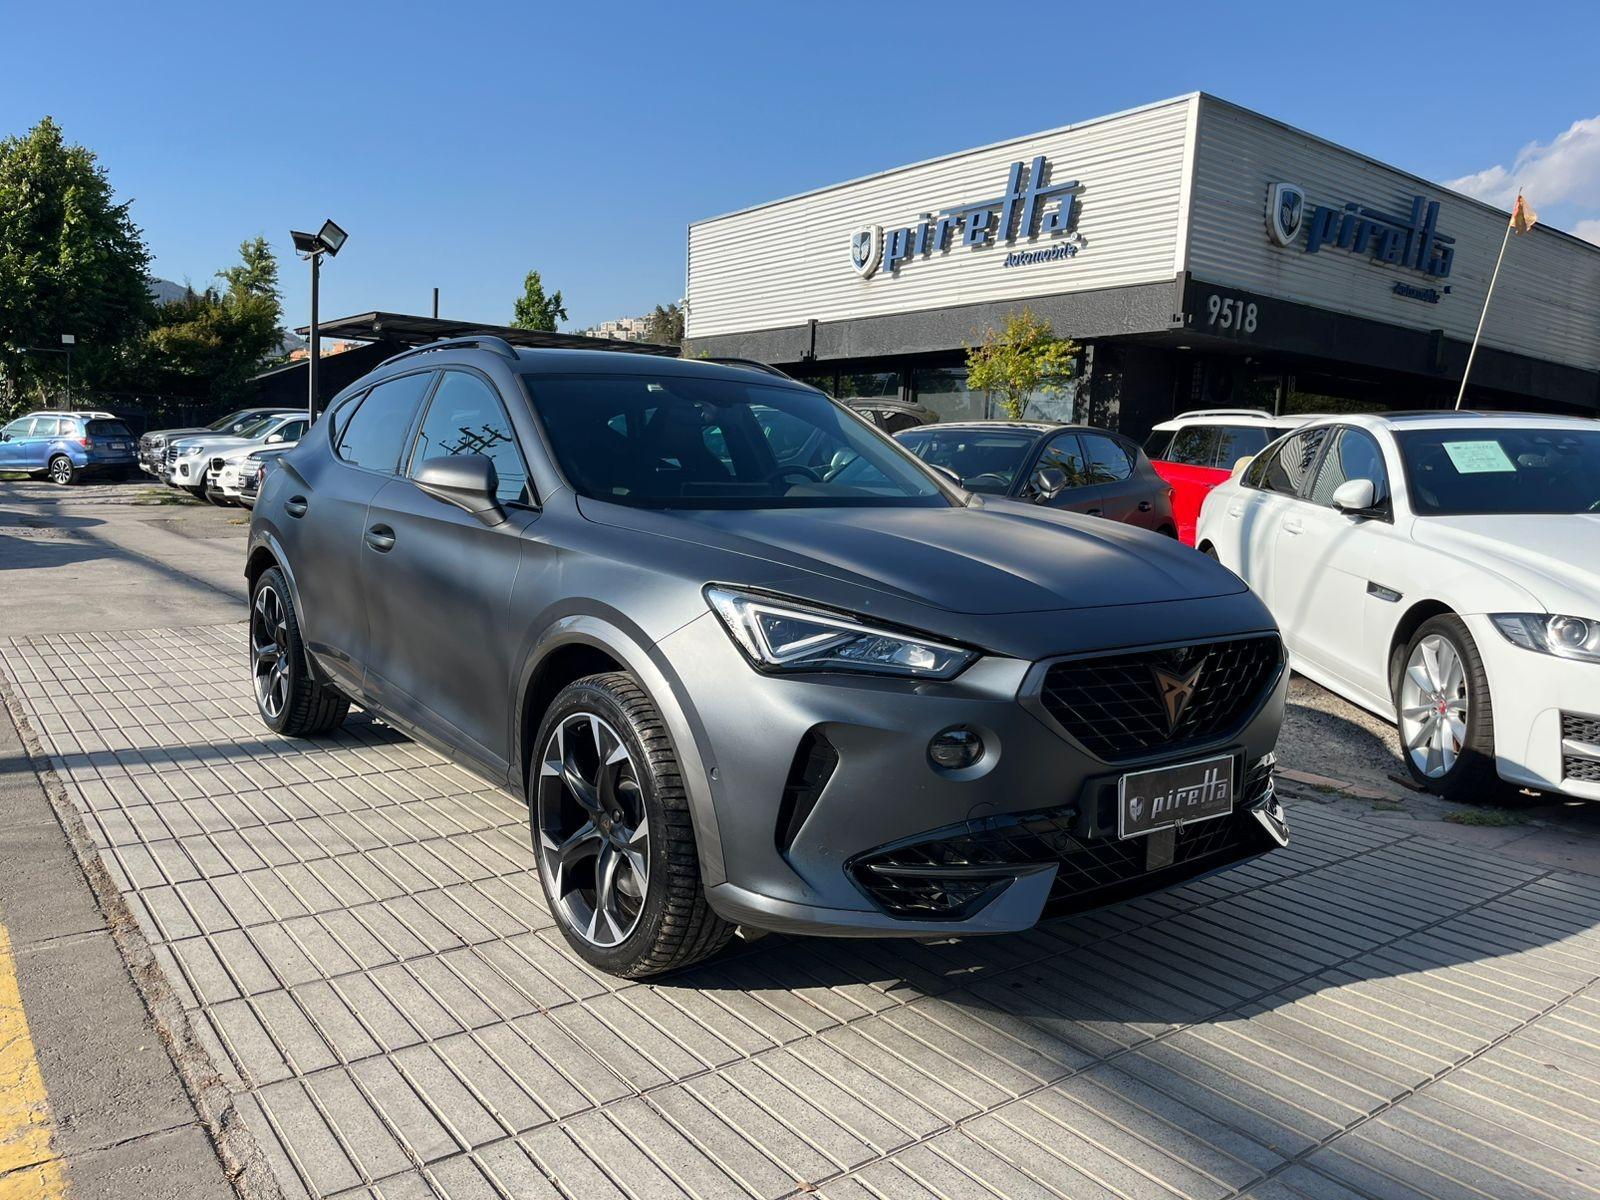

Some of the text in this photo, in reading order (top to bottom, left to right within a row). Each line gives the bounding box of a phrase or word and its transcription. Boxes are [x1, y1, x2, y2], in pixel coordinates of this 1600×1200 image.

[883, 155, 1079, 272] piretta
[1004, 242, 1077, 267] Automobile
[1208, 294, 1258, 333] 9518
[1151, 768, 1228, 819] piretta
